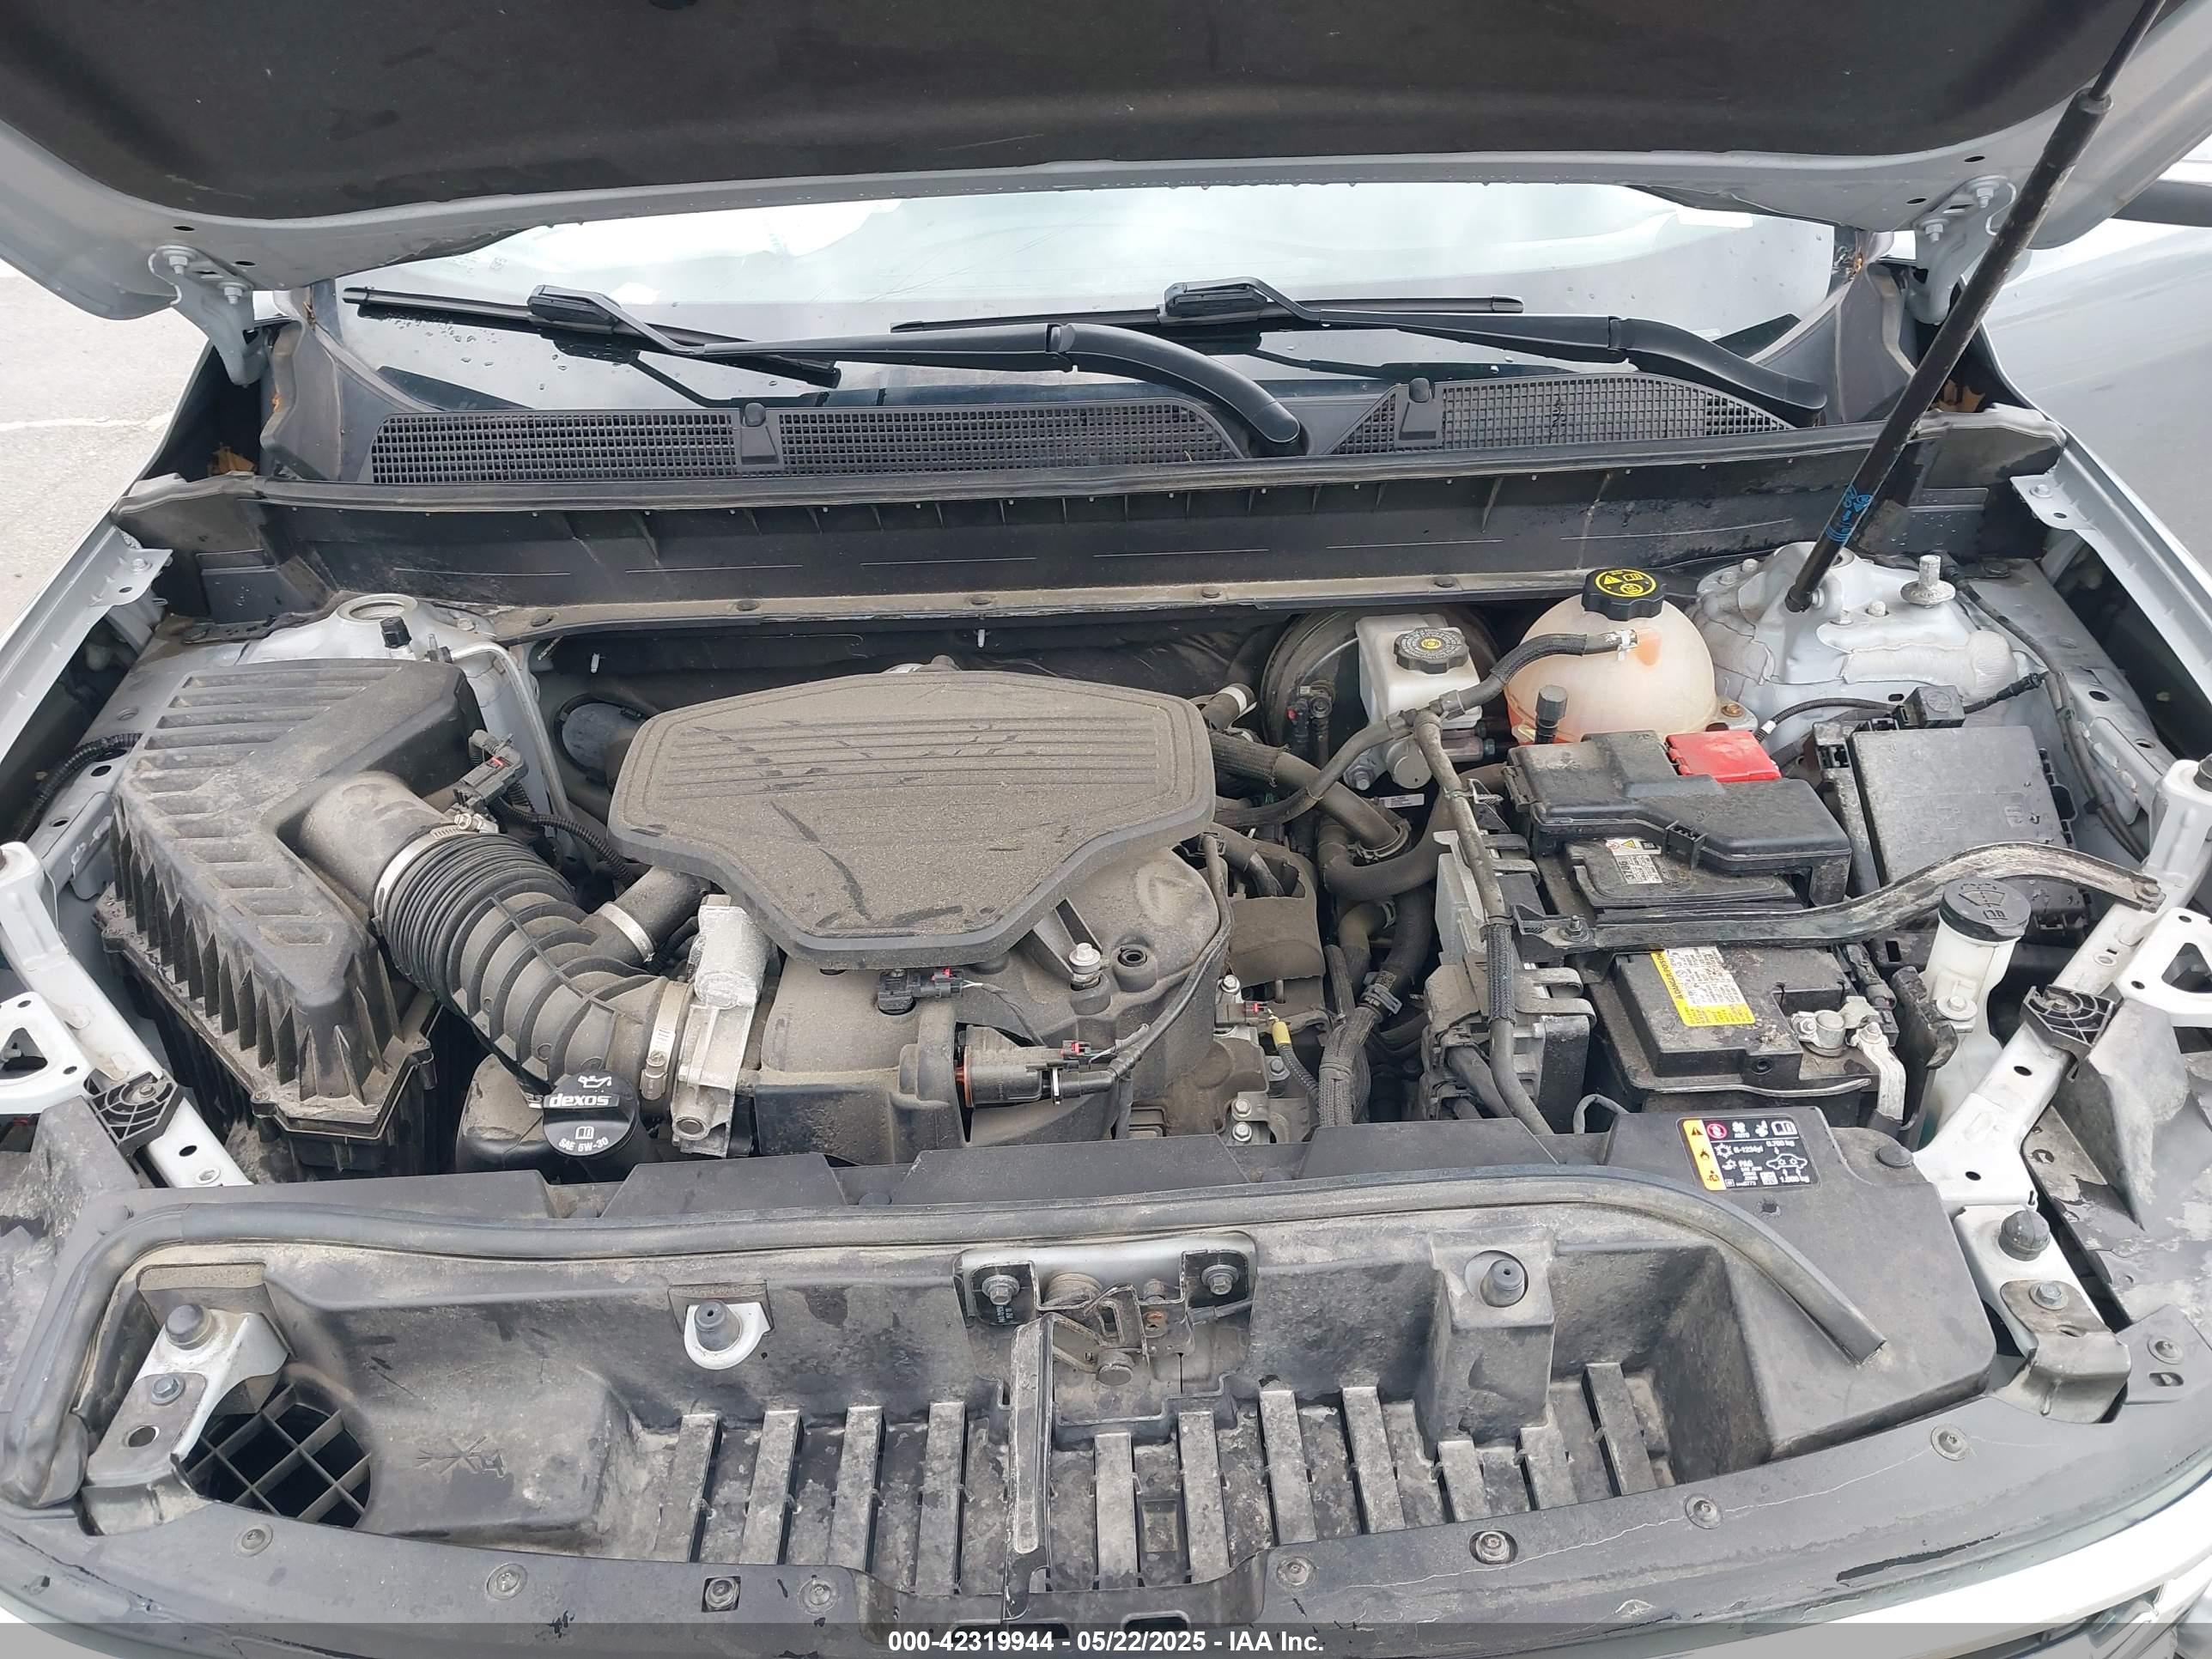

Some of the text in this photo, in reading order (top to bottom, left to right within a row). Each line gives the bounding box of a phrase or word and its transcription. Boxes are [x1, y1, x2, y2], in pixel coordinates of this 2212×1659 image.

[550, 1093, 611, 1107] dexos
[559, 1137, 609, 1152] SAE 5W-30
